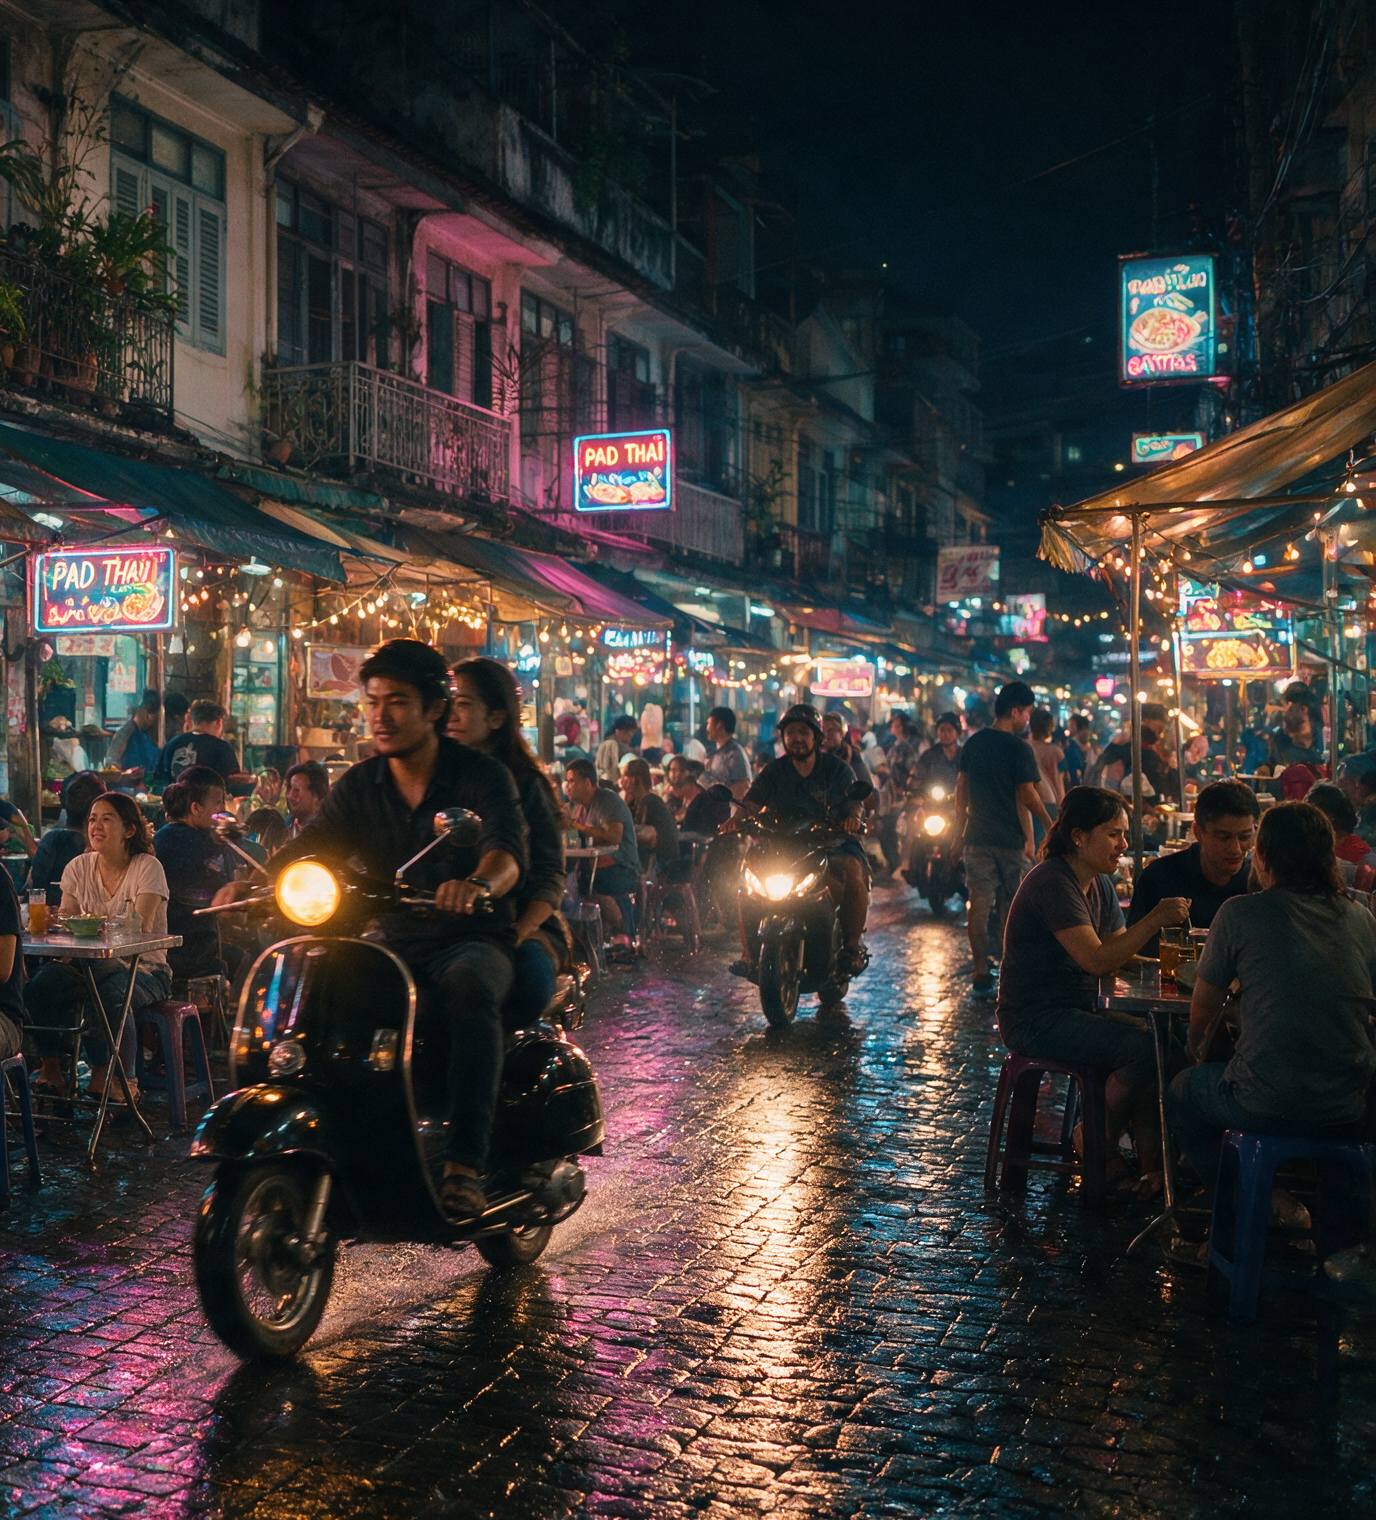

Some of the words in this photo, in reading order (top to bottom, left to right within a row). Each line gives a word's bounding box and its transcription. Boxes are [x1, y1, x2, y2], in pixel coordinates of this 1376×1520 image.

[585, 446, 618, 467] PAD
[624, 441, 664, 464] THAI
[52, 560, 95, 590] PAD
